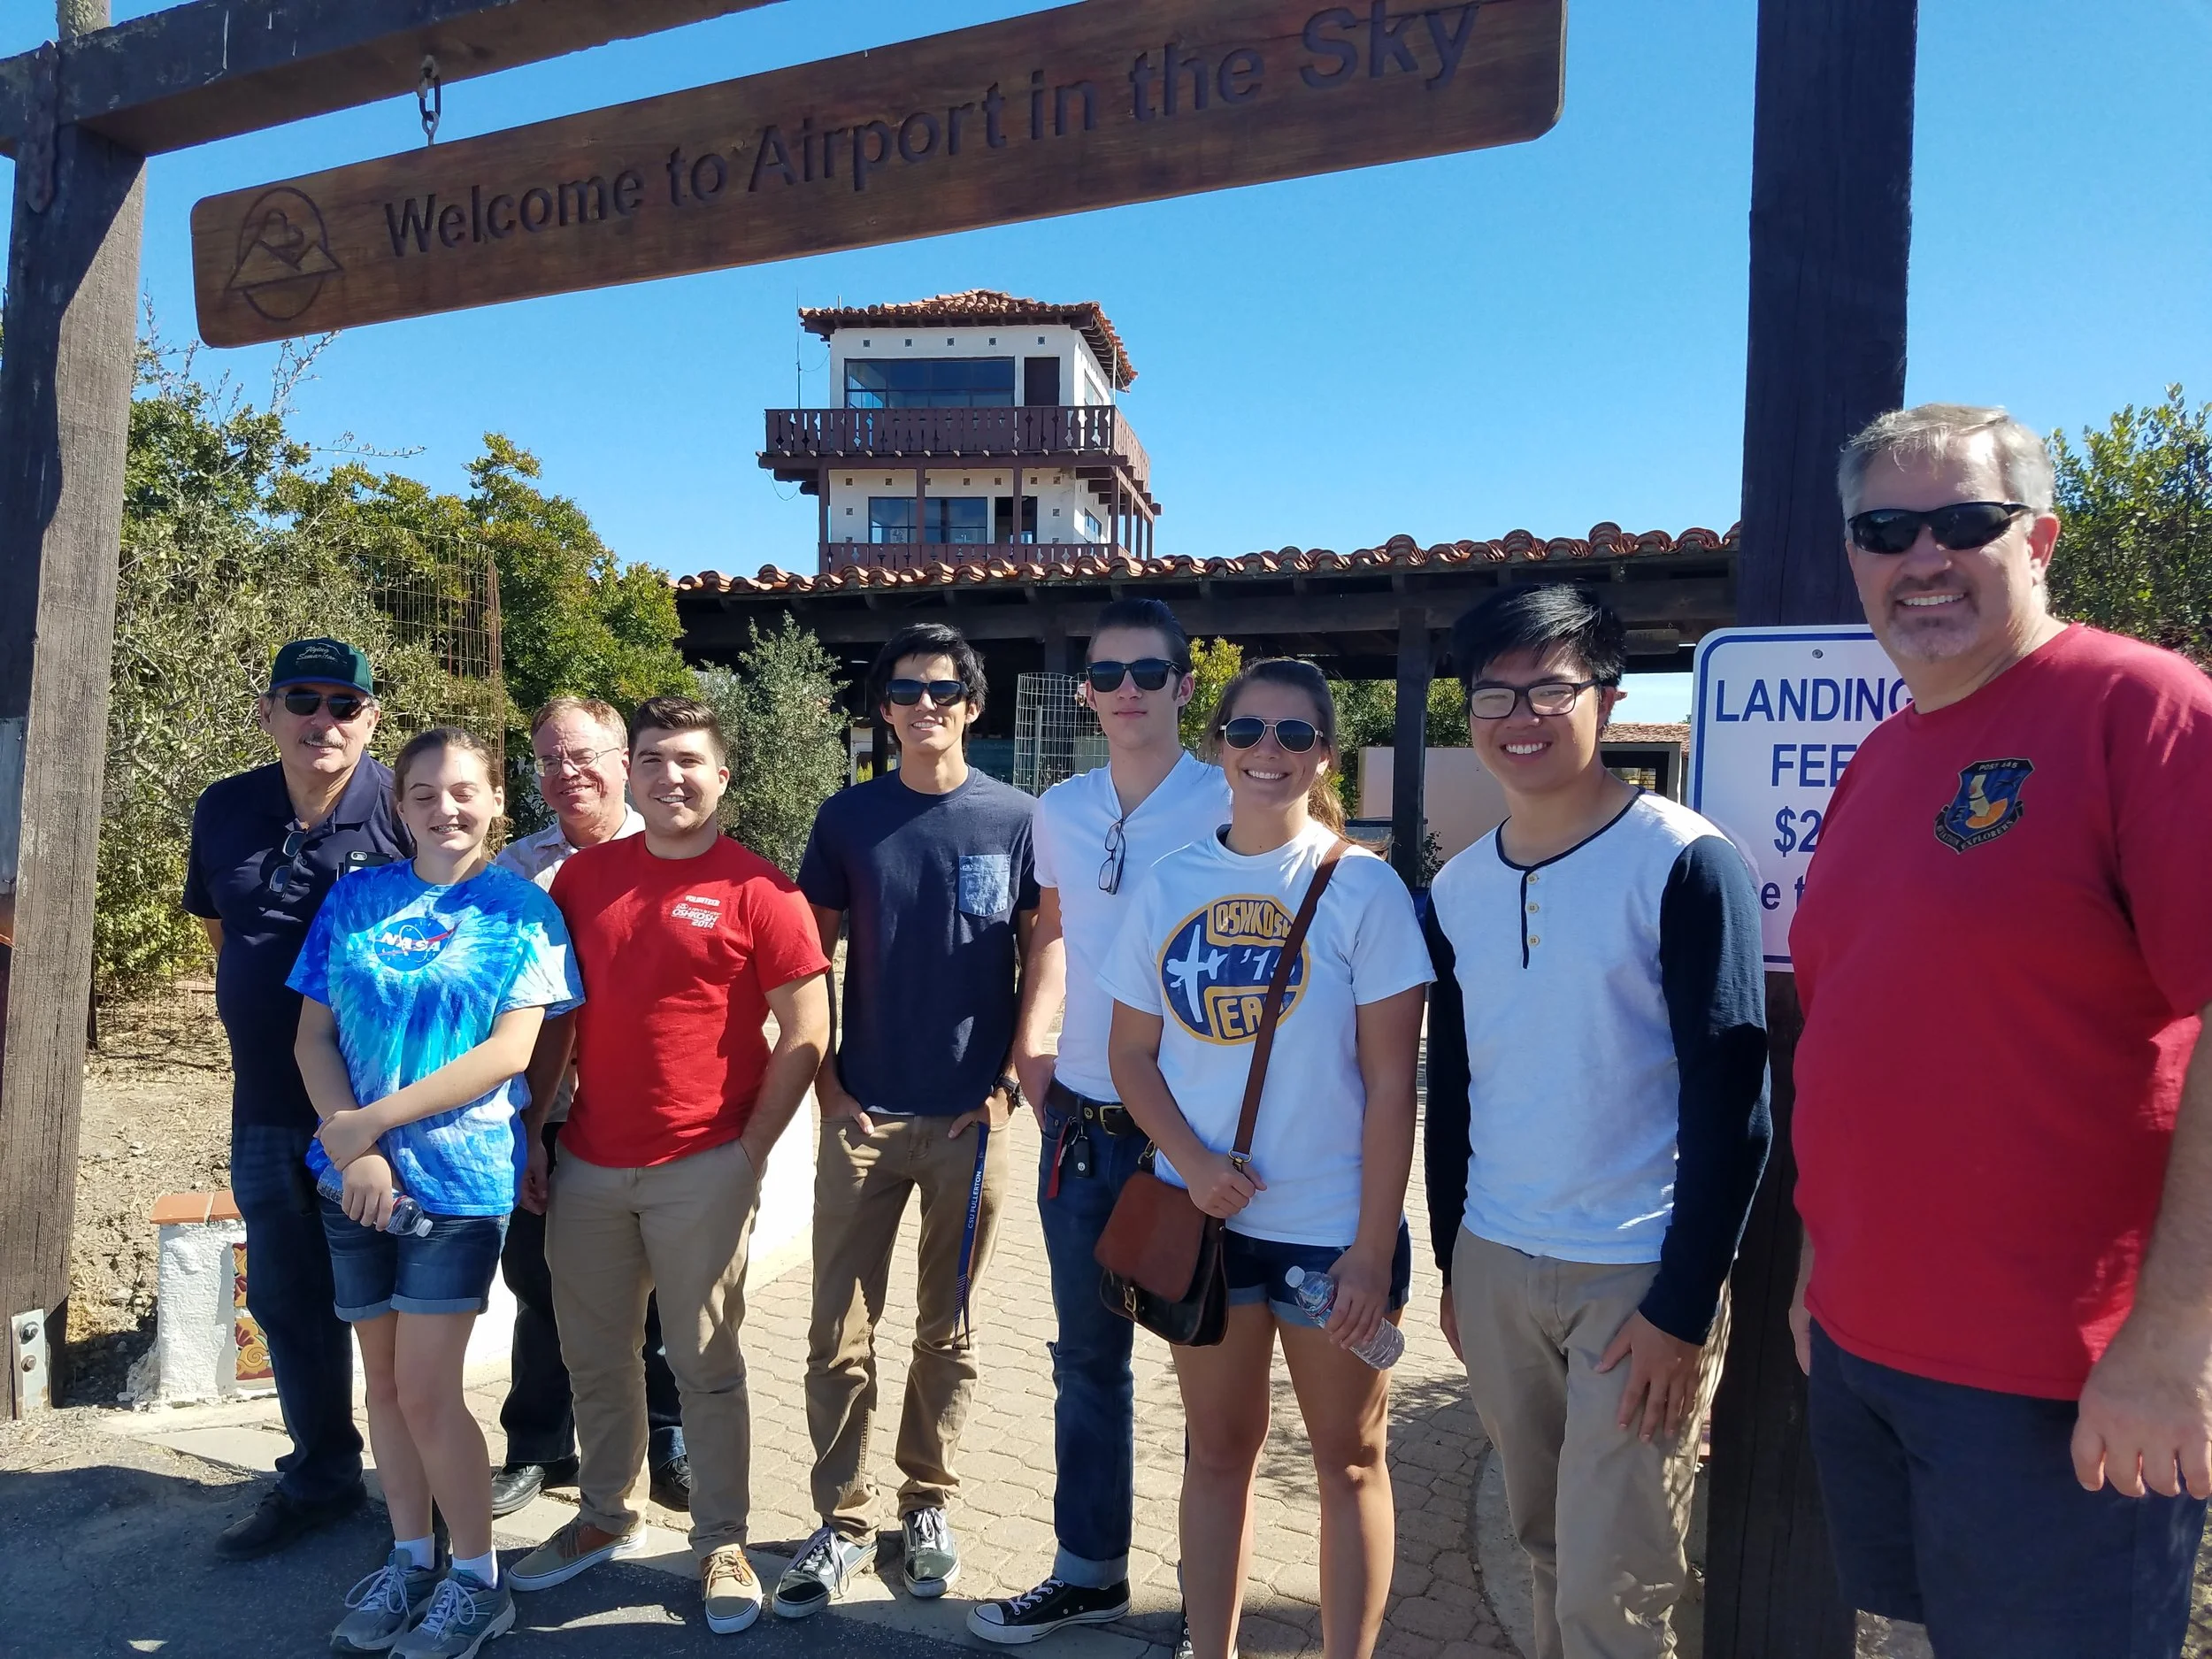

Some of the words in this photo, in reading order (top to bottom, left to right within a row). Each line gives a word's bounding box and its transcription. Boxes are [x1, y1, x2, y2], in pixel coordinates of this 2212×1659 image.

[384, 168, 643, 257] Welcome
[666, 146, 729, 206] to
[748, 81, 1007, 192] Airport
[1029, 69, 1097, 140] in
[1130, 42, 1263, 122] the
[1300, 0, 1480, 89] Sky
[304, 646, 329, 656] Flying
[1716, 678, 1913, 722] LANDING
[1771, 743, 1857, 787] FEE
[1774, 805, 1823, 857] $2
[1961, 819, 2014, 849] EXPLORERS
[672, 909, 719, 923] OSHKOSH
[691, 919, 715, 929] 2014
[1217, 902, 1292, 938] OSHKOSH
[380, 932, 441, 951] NASA
[1240, 949, 1295, 980] '1
[1217, 997, 1283, 1037] EA
[971, 1171, 981, 1212] FULLERTON
